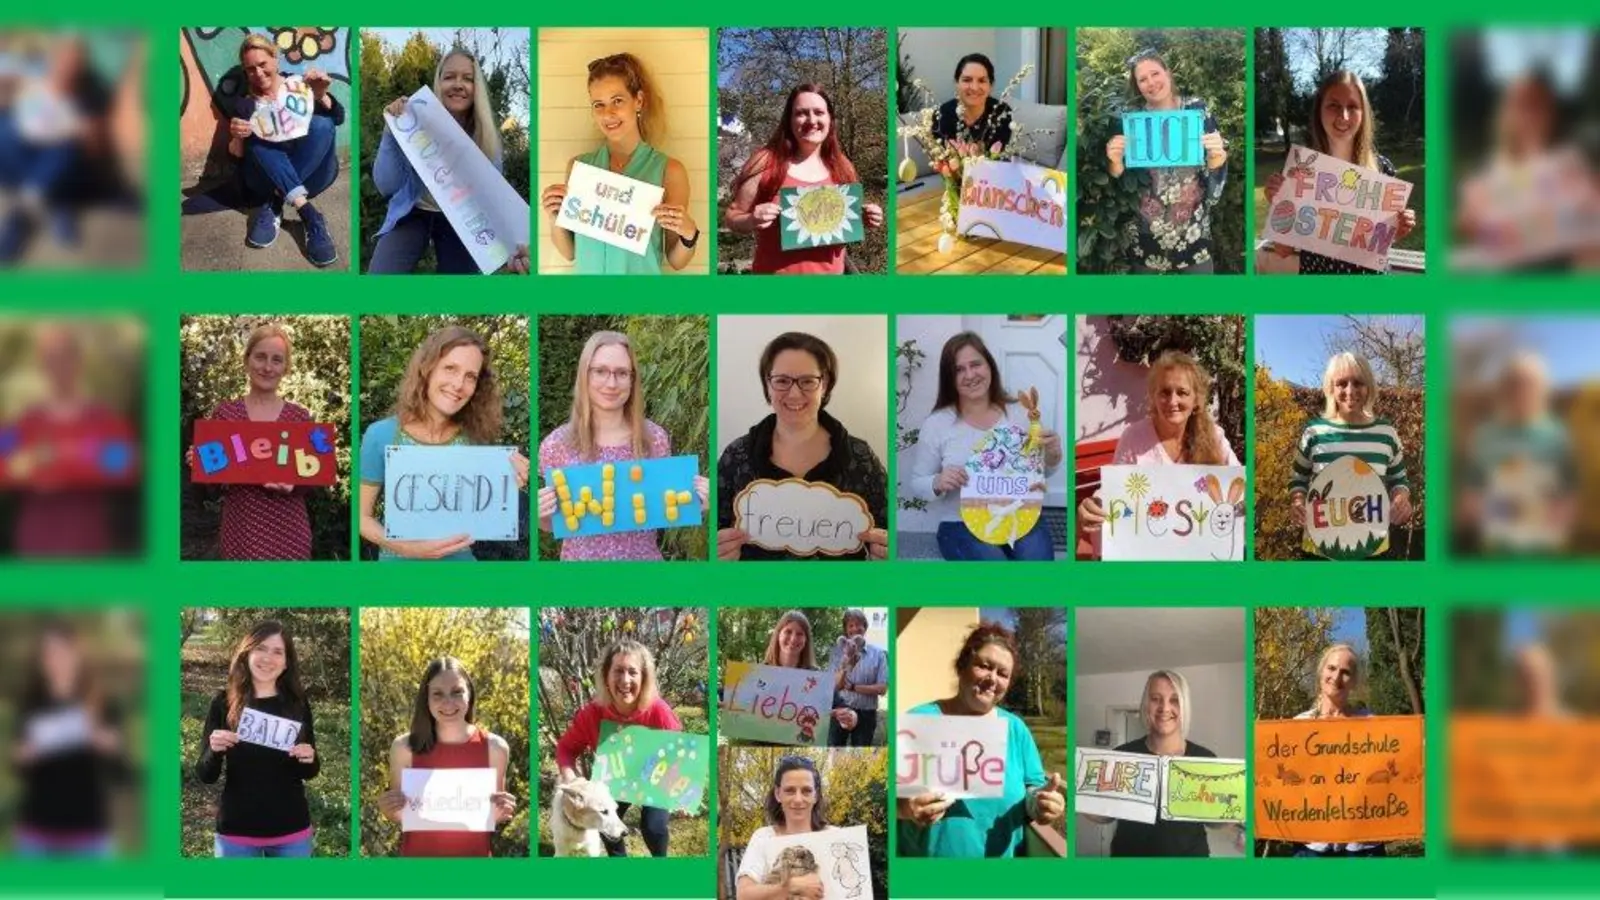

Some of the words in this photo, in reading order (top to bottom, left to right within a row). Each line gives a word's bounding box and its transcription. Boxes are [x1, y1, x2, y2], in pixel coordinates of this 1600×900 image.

[256, 80, 309, 137] LIEBE
[1127, 115, 1201, 163] EUCH
[595, 182, 635, 204] und
[564, 197, 648, 242] Schüler
[1270, 200, 1396, 255] OSTERN
[196, 427, 333, 476] Bleibt
[551, 463, 692, 531] Wir
[977, 475, 1028, 495] uns
[744, 490, 854, 540] freuen
[1312, 494, 1383, 529] EUCH
[729, 677, 820, 728] Liebe
[240, 713, 298, 747] BALD
[1267, 733, 1298, 759] der
[1305, 731, 1400, 757] Grundschule
[896, 729, 1004, 791] Grüße
[1079, 760, 1155, 797] EURE
[1309, 773, 1326, 785] an
[1334, 767, 1360, 785] der
